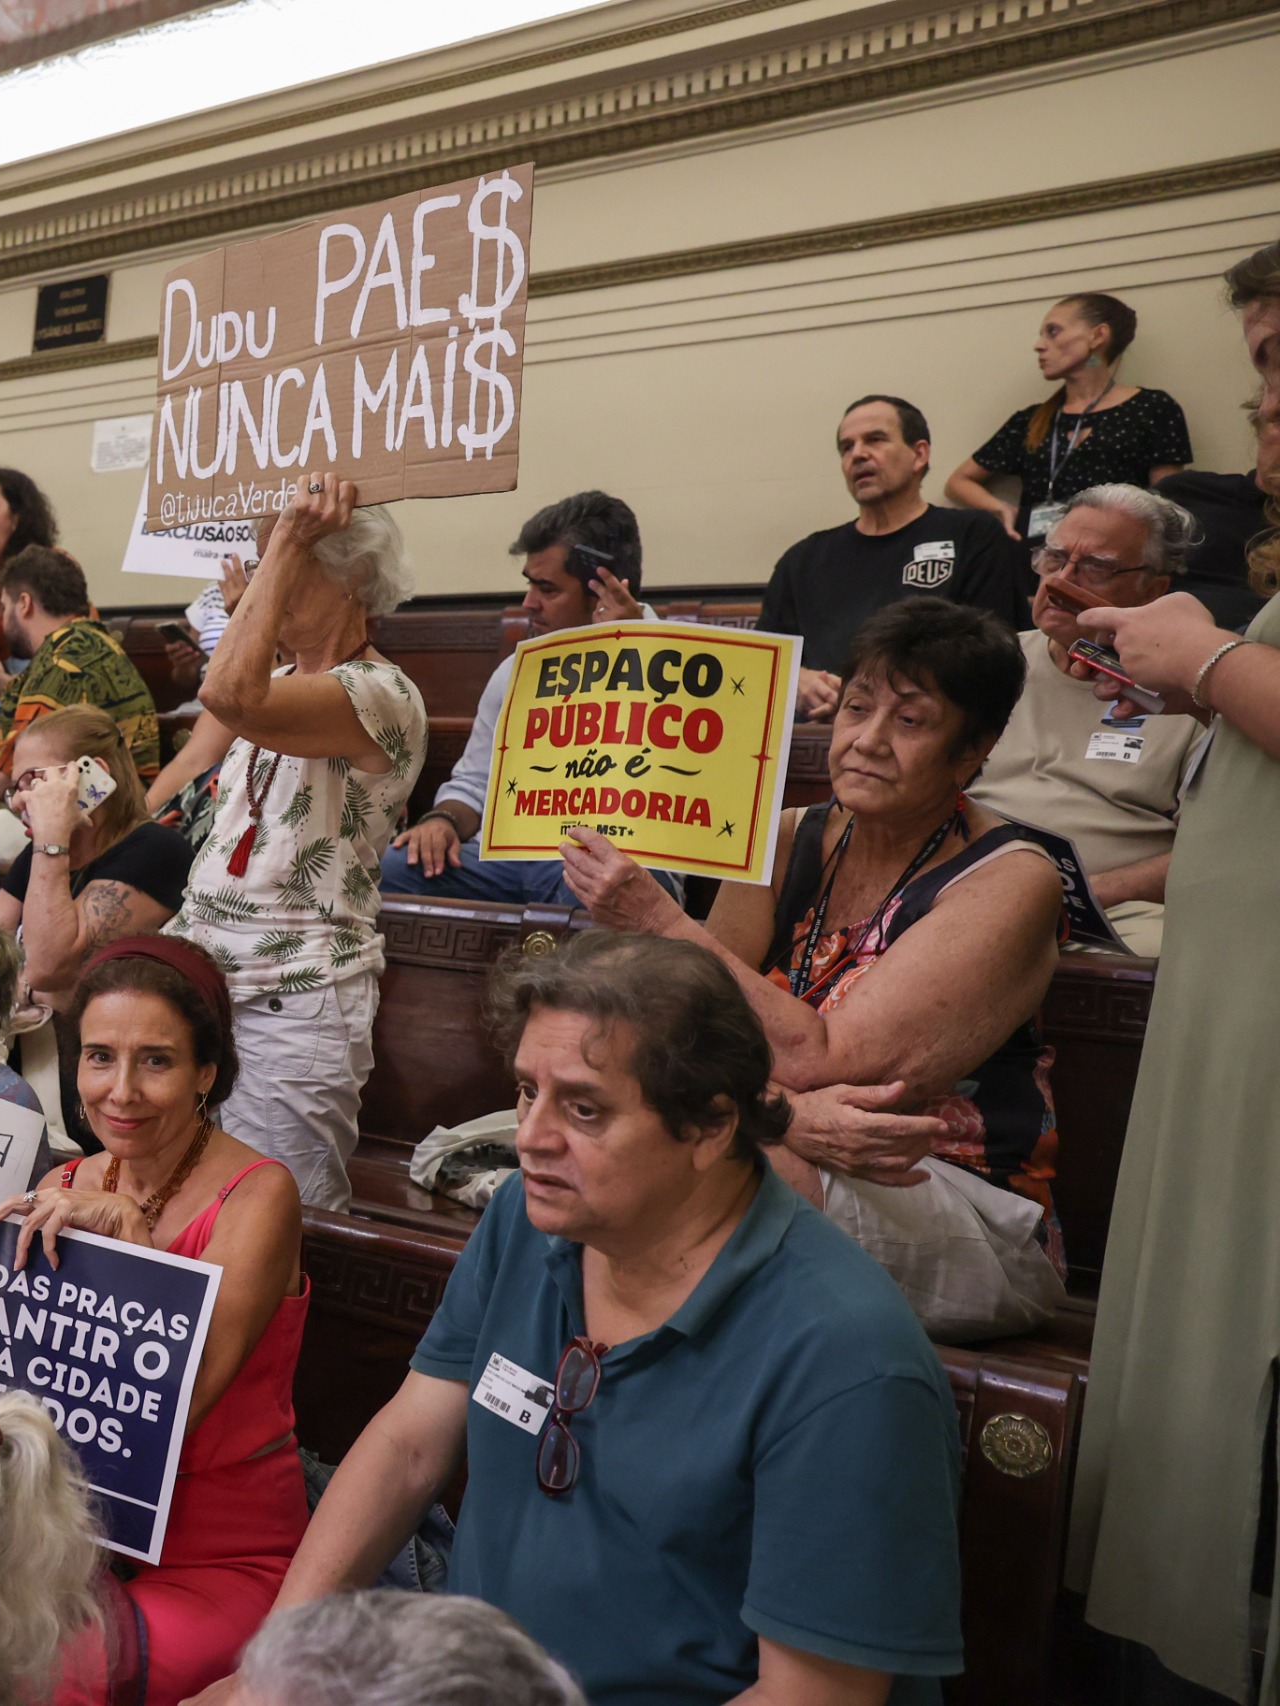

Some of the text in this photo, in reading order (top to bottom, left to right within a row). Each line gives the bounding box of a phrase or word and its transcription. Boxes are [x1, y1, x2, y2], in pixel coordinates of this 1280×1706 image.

[156, 363, 337, 484] NUNCA
[153, 522, 235, 542] CLUSÃO
[907, 560, 949, 584] DEUS
[535, 648, 724, 702] ESPAÇO
[523, 695, 724, 754] PÚBLICO
[565, 747, 653, 779] não é
[514, 787, 711, 828] MERCADORIA
[57, 1281, 190, 1341] PRAÇAS
[133, 1341, 170, 1380] O
[26, 1357, 162, 1423] CIDADE
[519, 1409, 531, 1424] B
